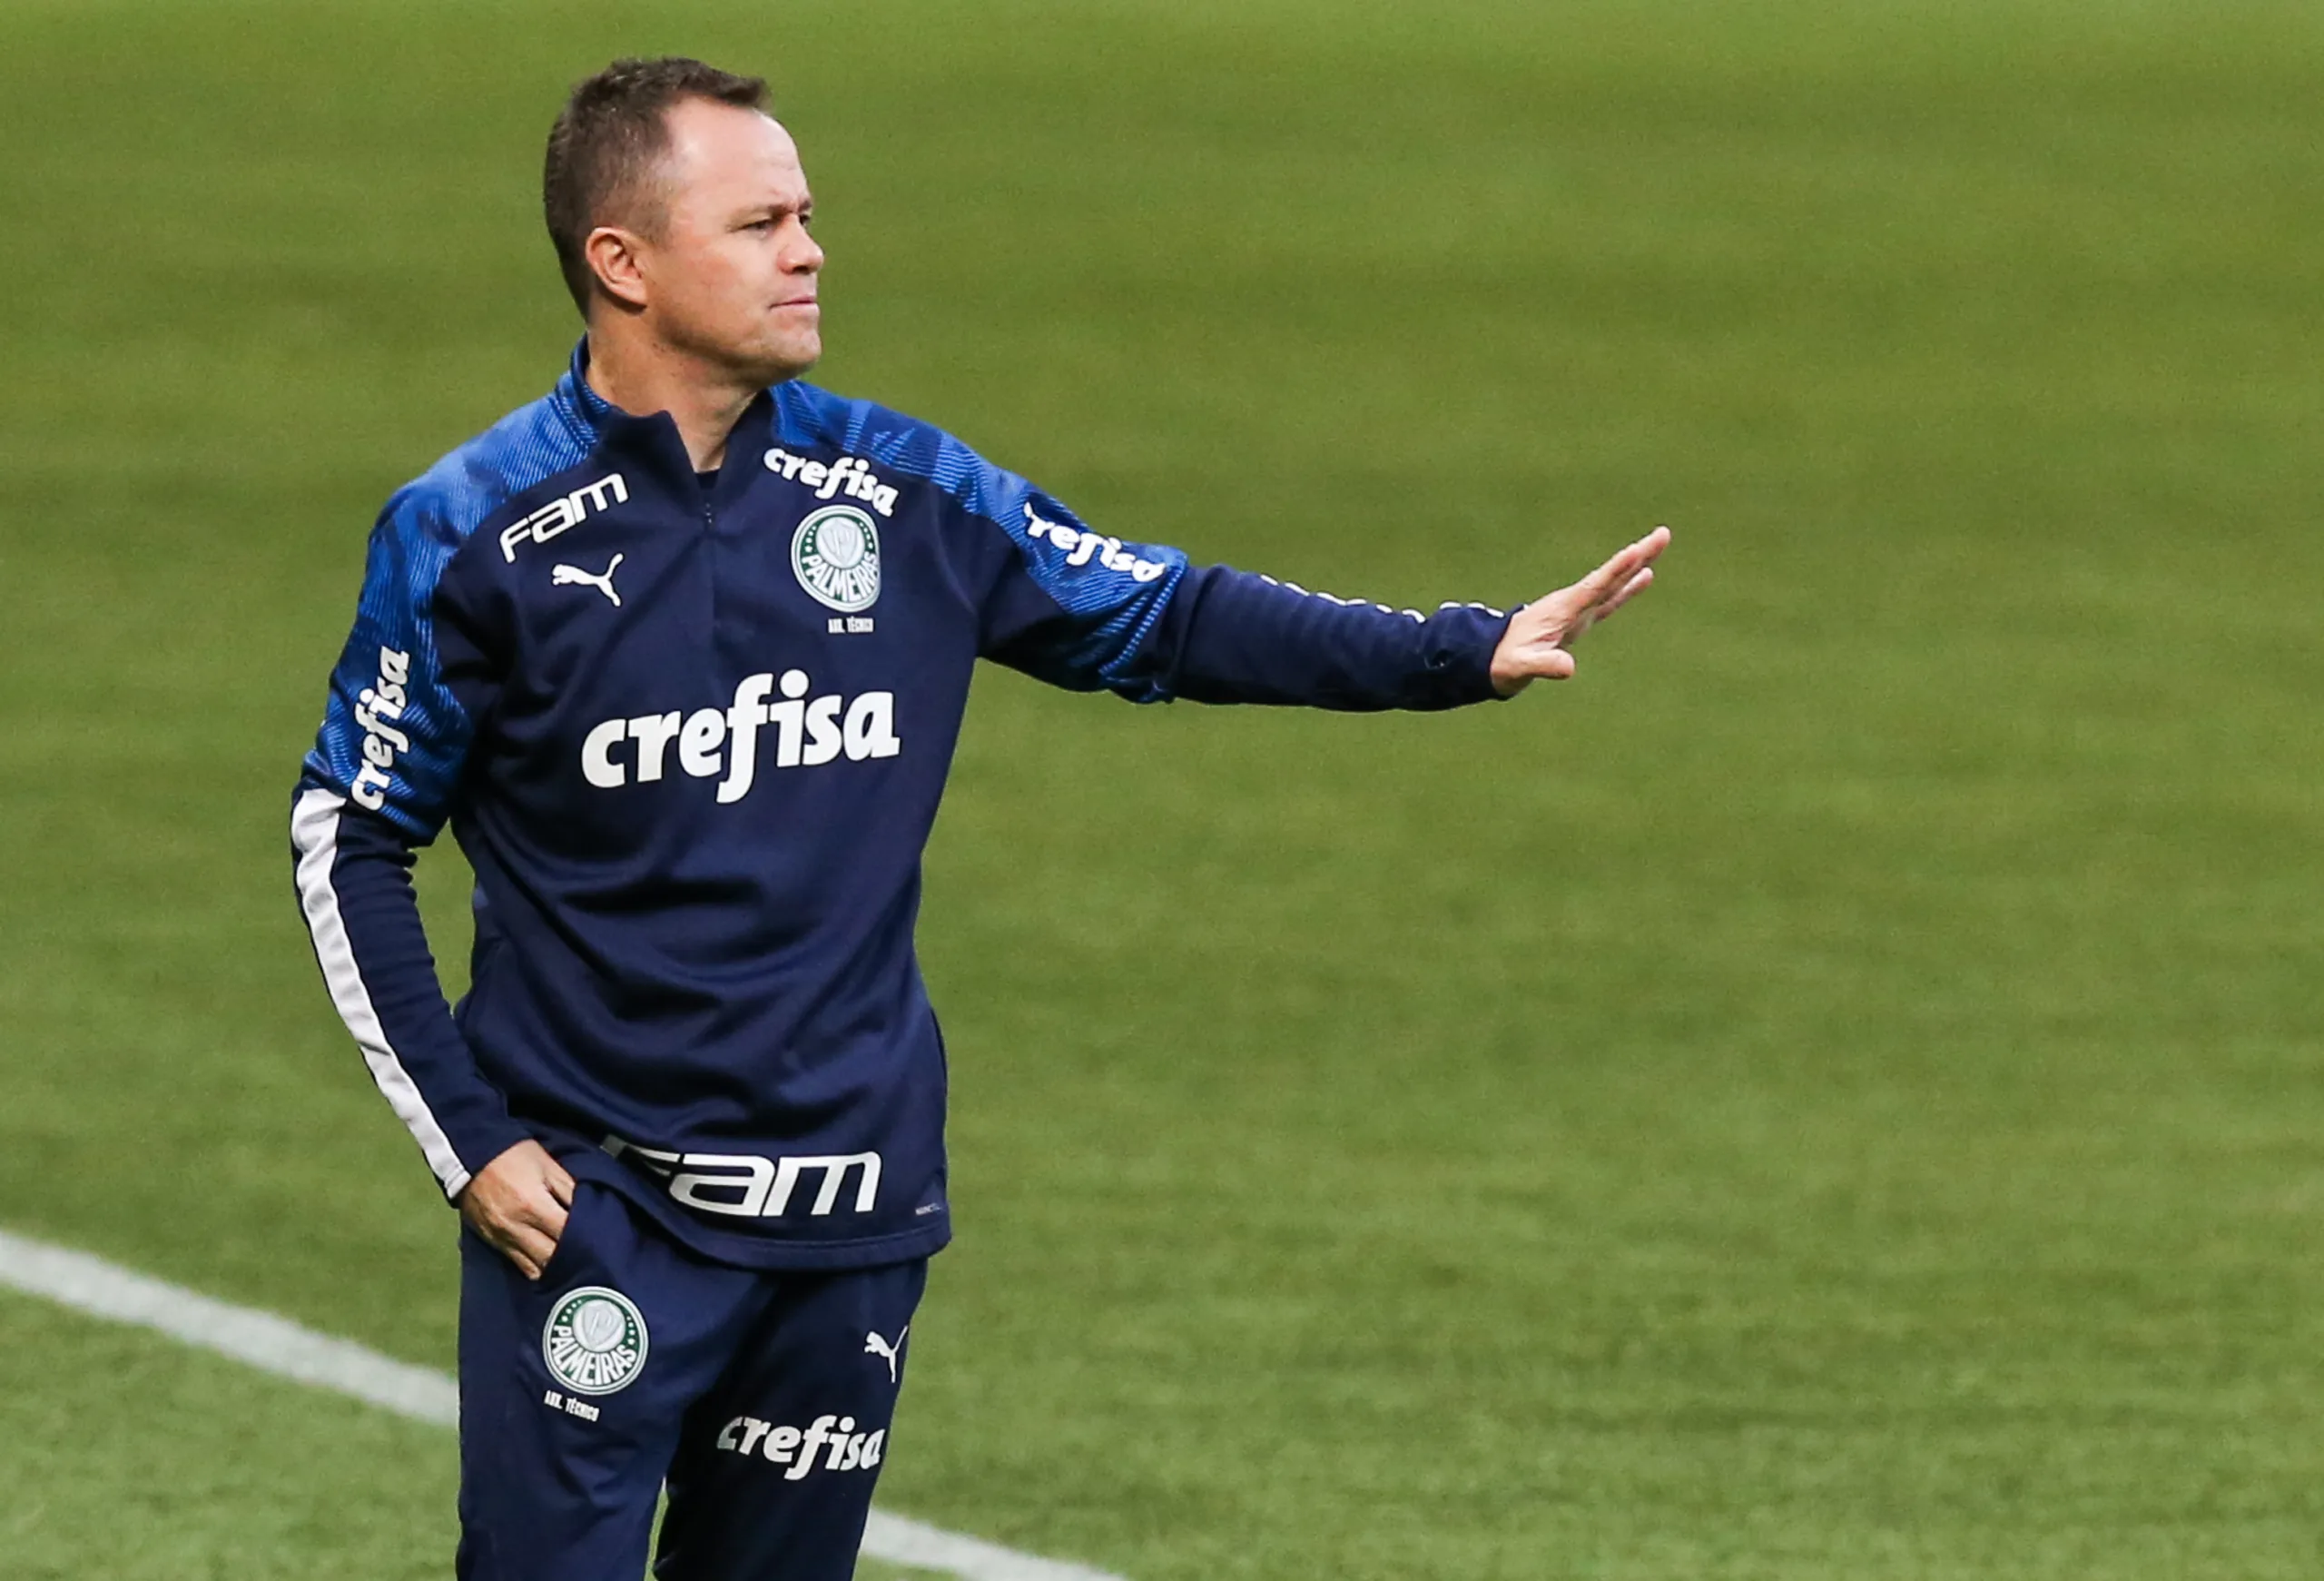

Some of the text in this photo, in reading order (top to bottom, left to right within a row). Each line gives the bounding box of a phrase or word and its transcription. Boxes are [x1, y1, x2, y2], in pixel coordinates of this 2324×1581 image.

[763, 448, 899, 517] crefisa
[801, 551, 880, 602] PALMEIRAS
[351, 646, 409, 811] crefisa
[581, 668, 901, 804] crefisa
[551, 1325, 636, 1386] PALMEIRAS
[717, 1414, 886, 1481] crefisa
